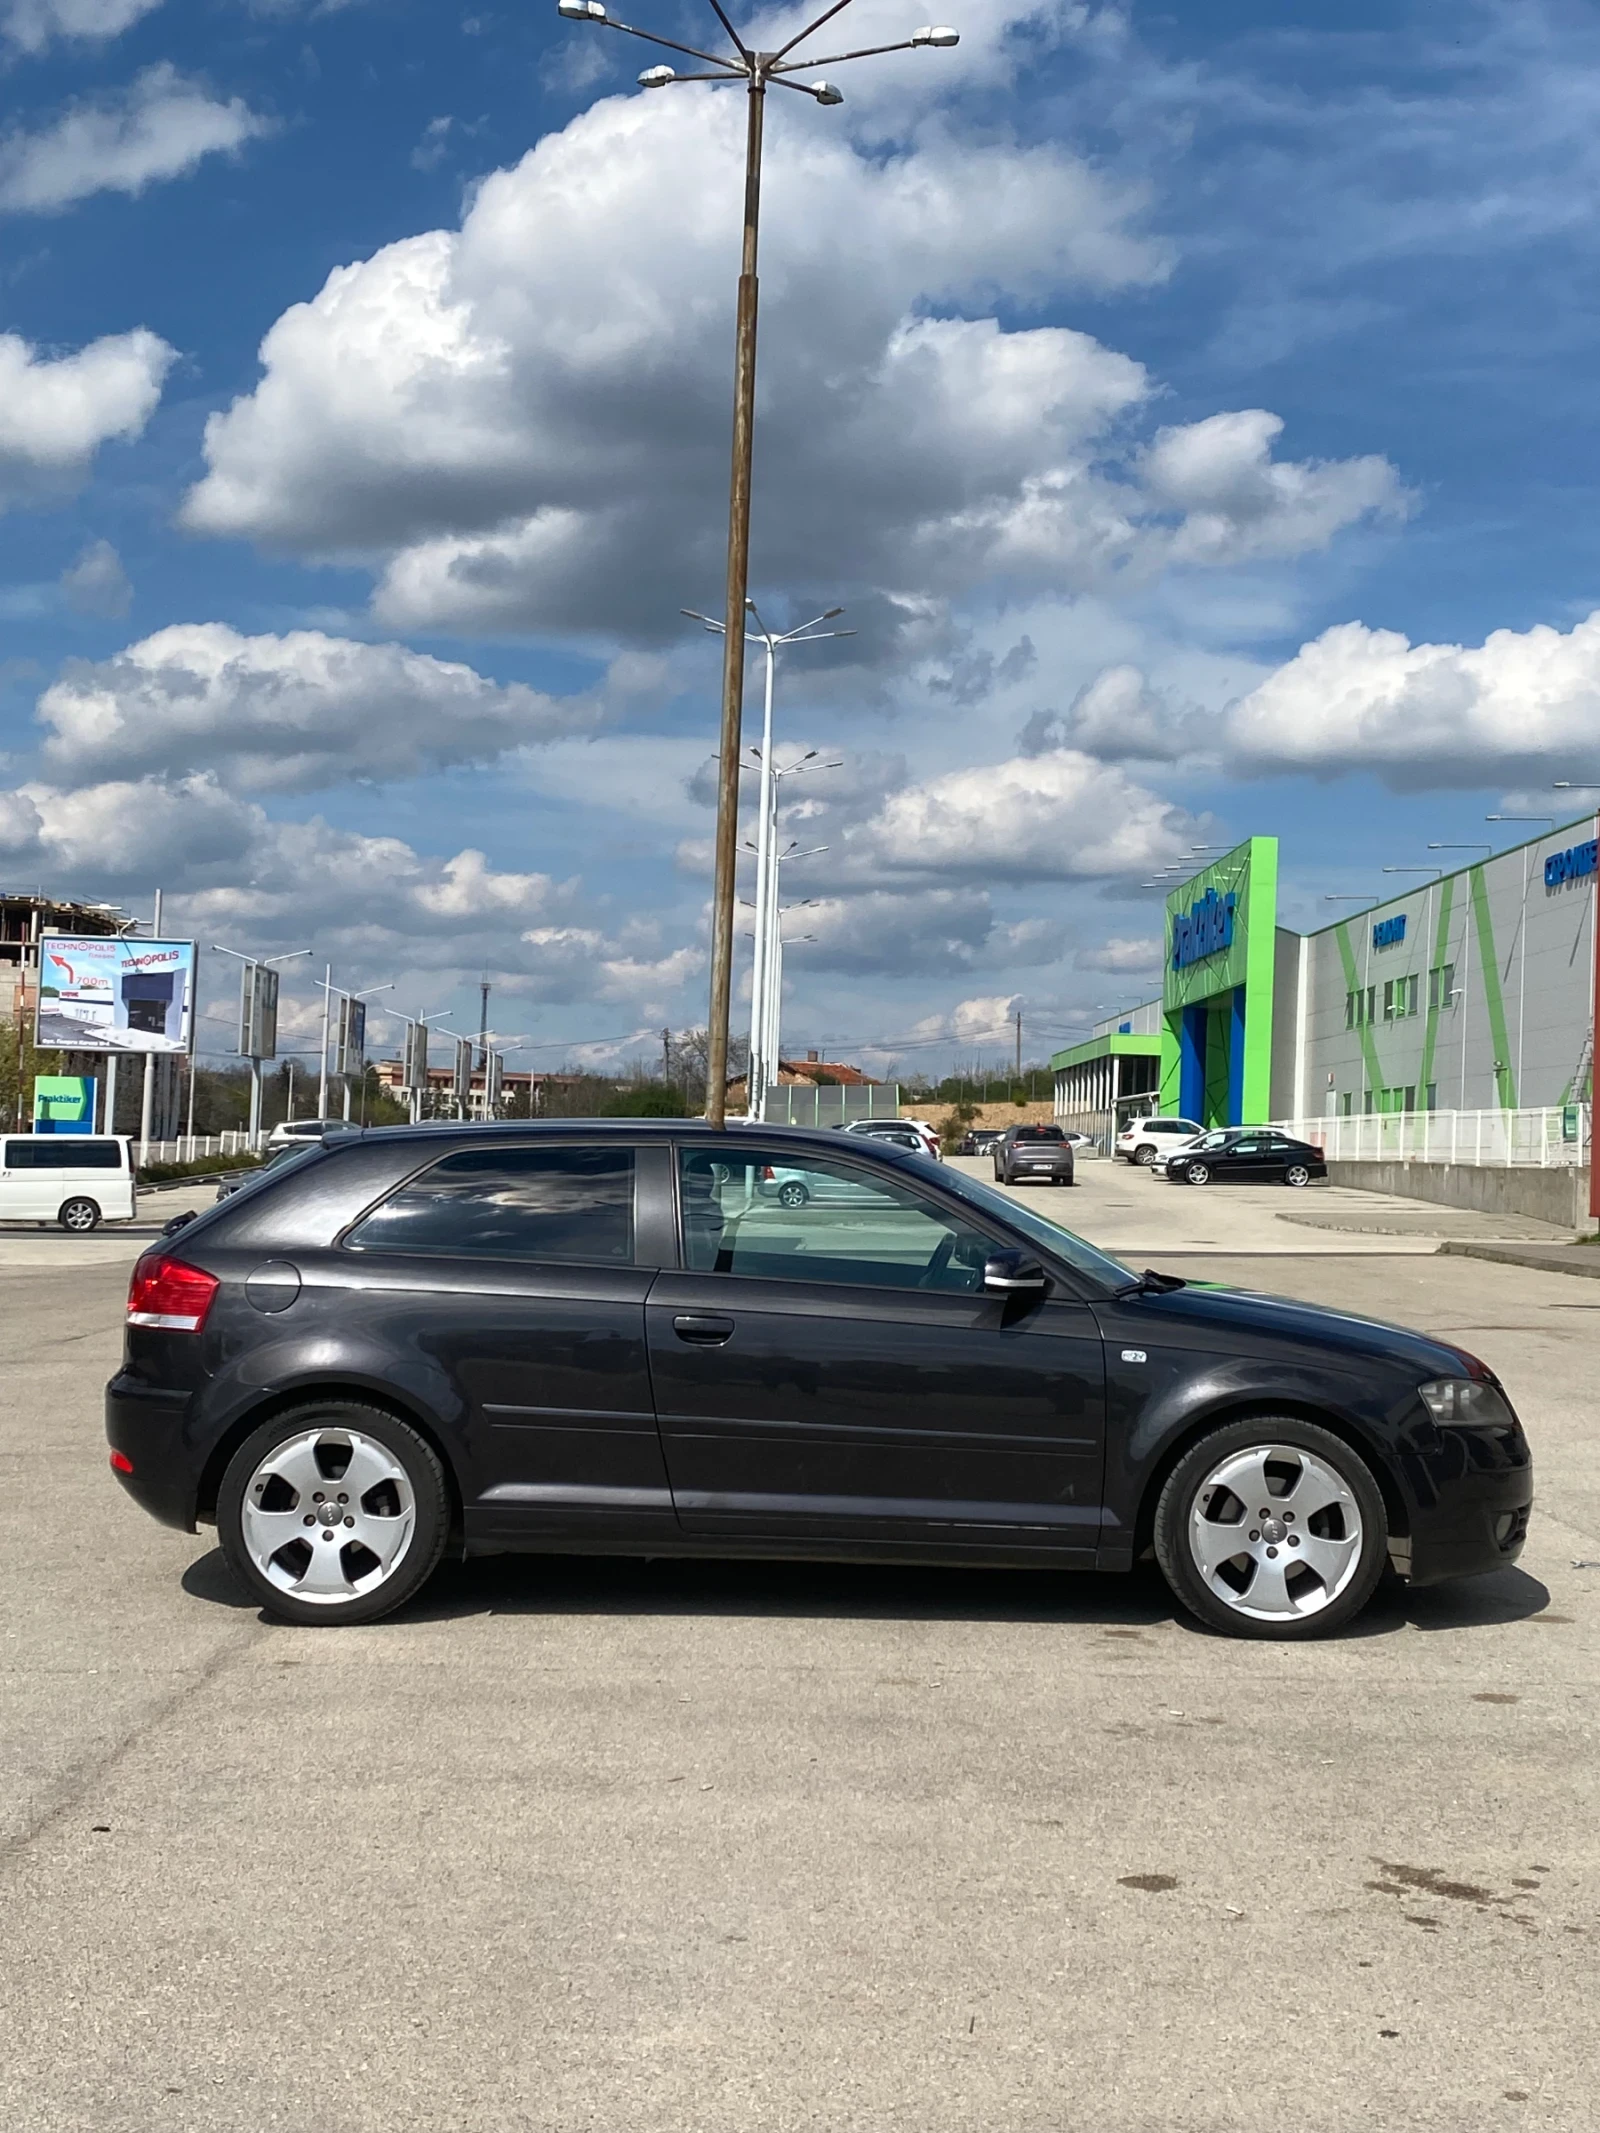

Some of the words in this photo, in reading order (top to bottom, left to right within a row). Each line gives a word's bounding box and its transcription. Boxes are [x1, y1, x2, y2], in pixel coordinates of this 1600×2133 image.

[1172, 887, 1236, 972] Praktiker
[46, 941, 116, 952] TECHNOPOLIS
[121, 950, 179, 968] TECHNOPOLIS
[38, 1094, 81, 1103] Praktiker
